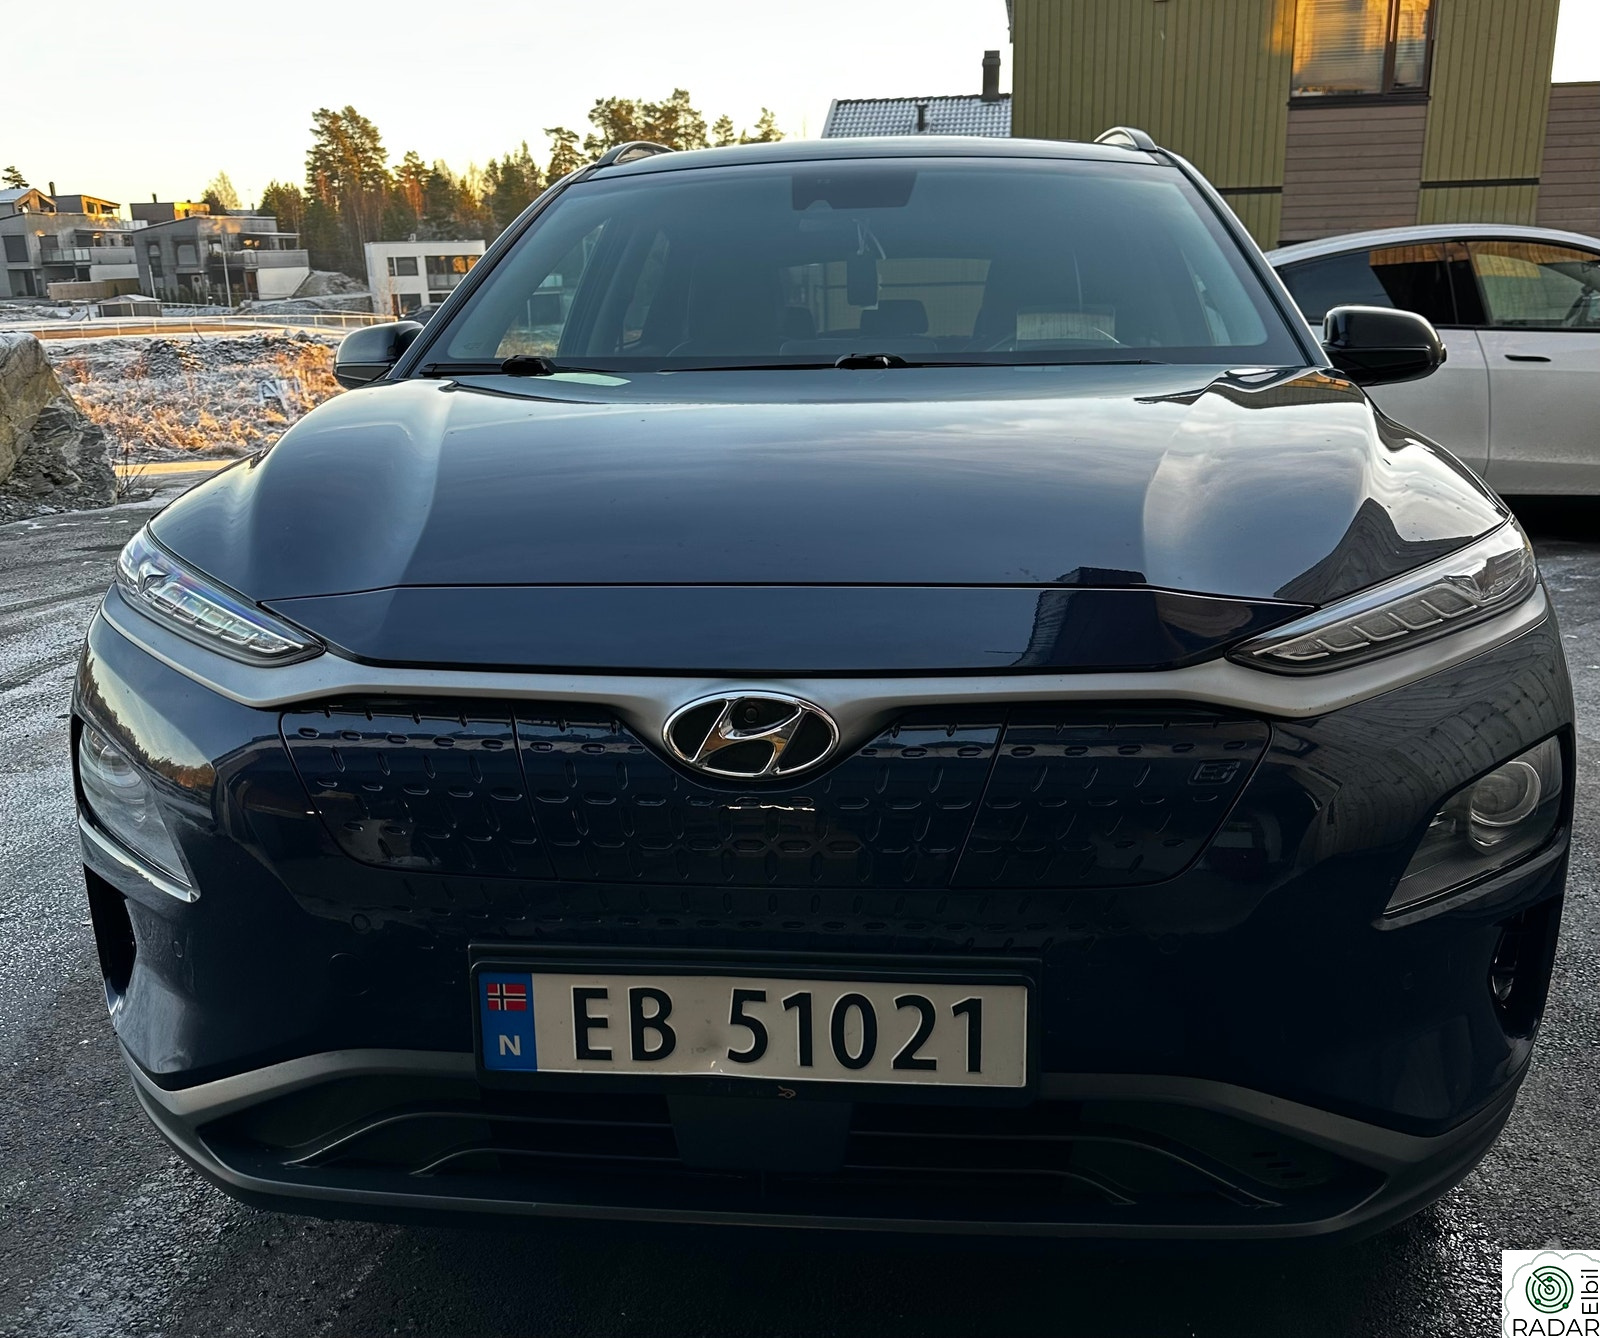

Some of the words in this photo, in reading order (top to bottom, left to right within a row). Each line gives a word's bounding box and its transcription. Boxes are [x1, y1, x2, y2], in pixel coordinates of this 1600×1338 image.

[499, 1034, 521, 1056] N
[572, 986, 677, 1061] EB
[727, 988, 983, 1073] 51021
